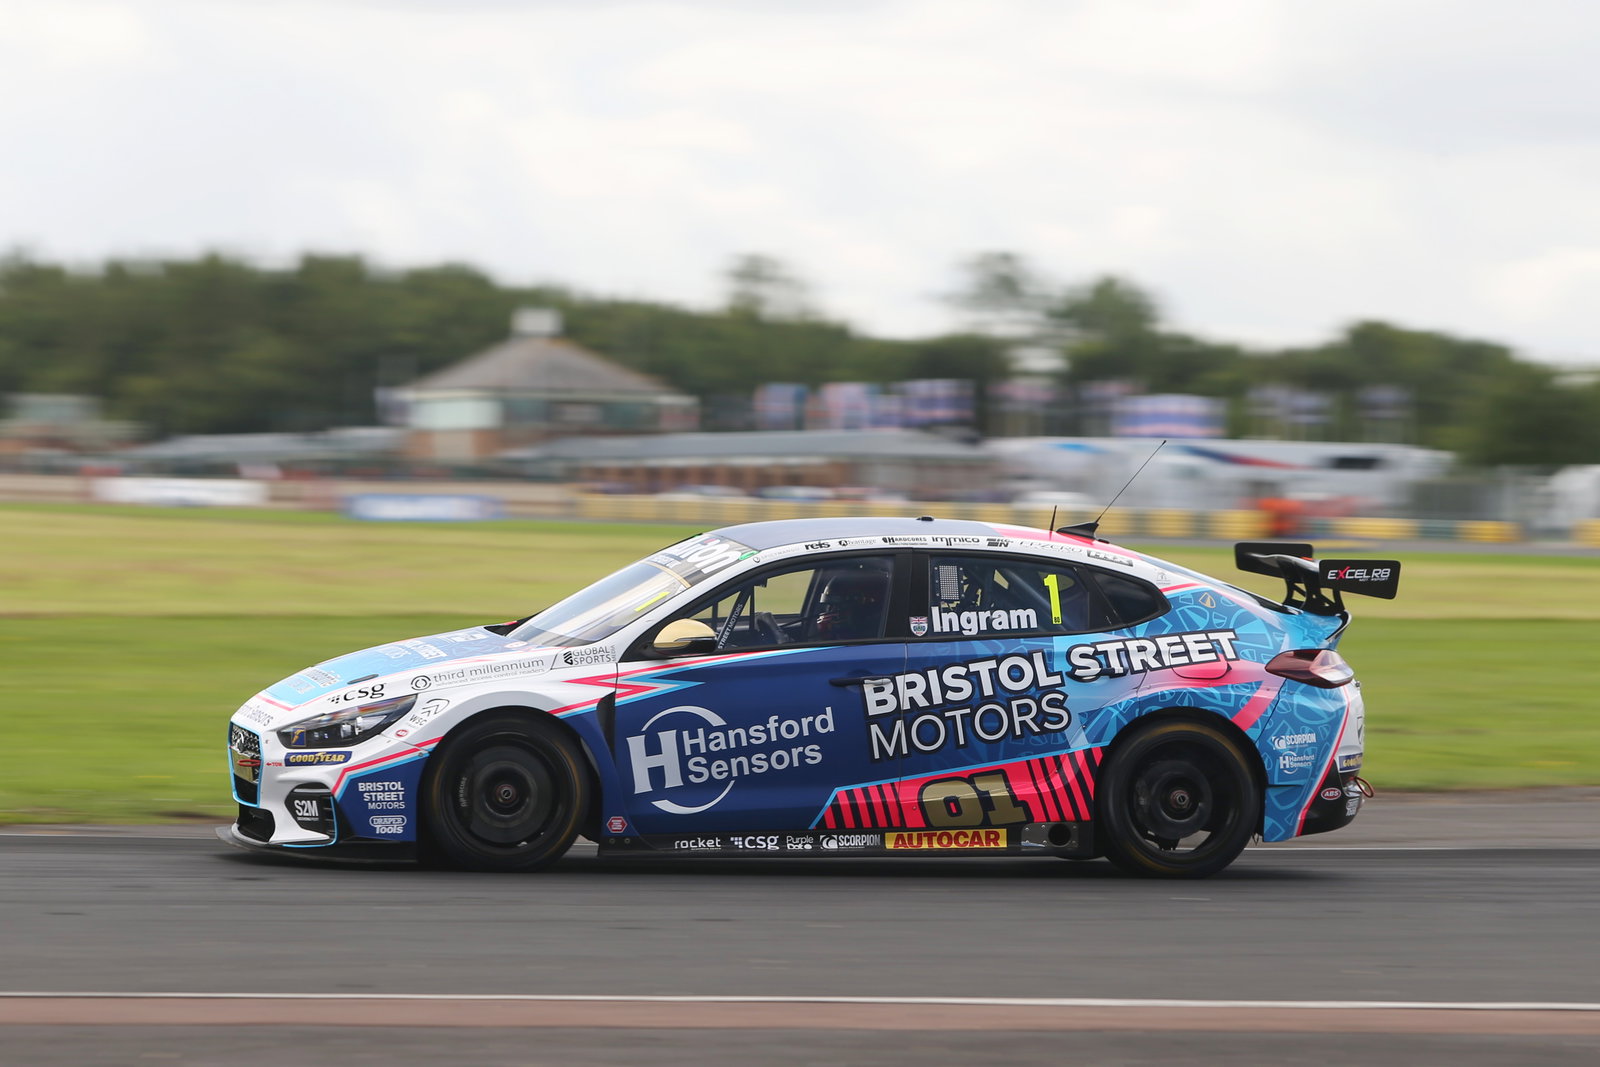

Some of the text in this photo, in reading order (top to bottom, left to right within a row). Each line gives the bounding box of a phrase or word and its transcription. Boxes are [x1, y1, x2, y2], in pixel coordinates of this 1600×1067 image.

[805, 541, 831, 550] reis
[1043, 574, 1062, 624] 1
[717, 603, 743, 649] STREET MOTORS
[931, 606, 1037, 635] Ingram
[573, 646, 610, 656] GLOBAL
[574, 654, 611, 666] SPORTS
[434, 659, 544, 682] third millennium
[863, 631, 1237, 716] BRISTOL STREET
[343, 683, 387, 701] csg
[683, 707, 835, 756] Hansford
[870, 693, 1069, 759] MOTORS
[1286, 733, 1316, 745] SCORPION
[289, 752, 346, 764] GOODYEAR
[688, 744, 823, 783] Sensors
[1289, 754, 1315, 762] Hansford
[358, 781, 405, 791] BRISTOL
[363, 792, 405, 801] STREET
[294, 800, 319, 817] S2M
[368, 801, 406, 809] MOTORS
[674, 837, 722, 849] rocket
[744, 835, 780, 850] csg
[786, 834, 814, 845] Purple
[838, 834, 880, 846] SCORPION
[893, 830, 1001, 849] AUTOCAR
